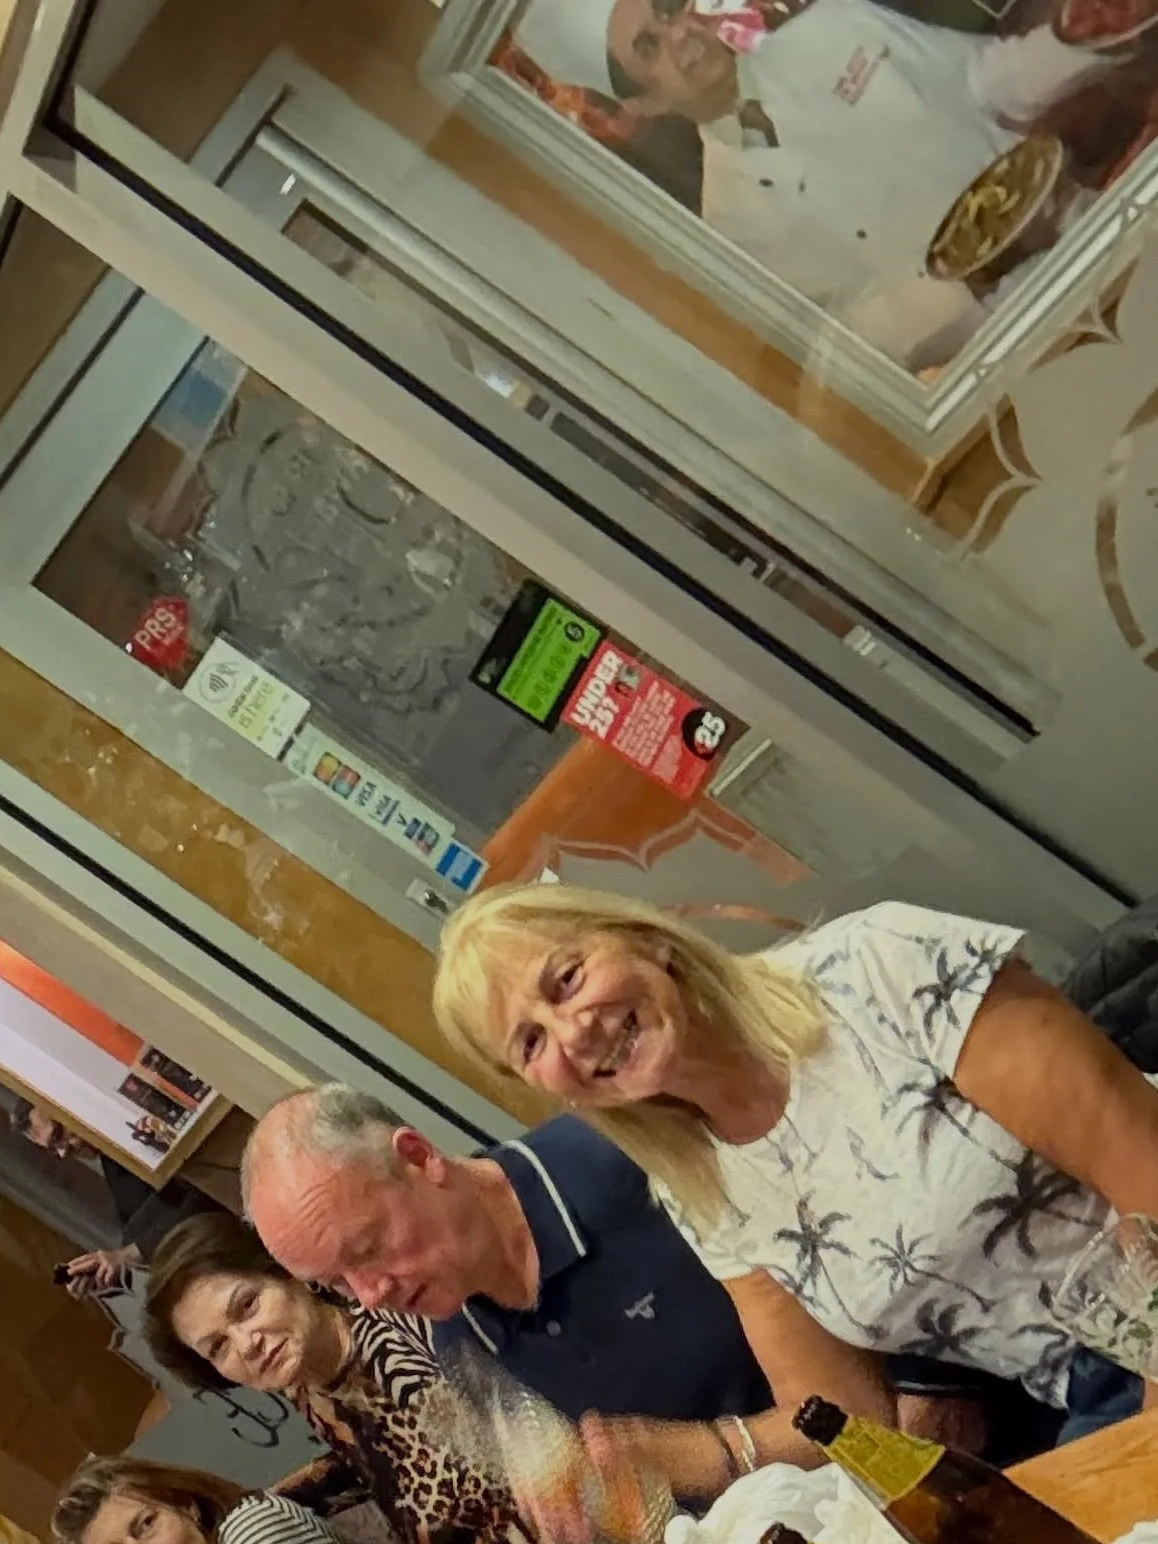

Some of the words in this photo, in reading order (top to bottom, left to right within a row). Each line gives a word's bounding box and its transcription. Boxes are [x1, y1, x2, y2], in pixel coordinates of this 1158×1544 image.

[133, 607, 176, 650] PRS
[569, 650, 623, 725] UNDER
[587, 696, 619, 739] 25?
[693, 711, 725, 750] 25
[354, 780, 376, 805] VISA
